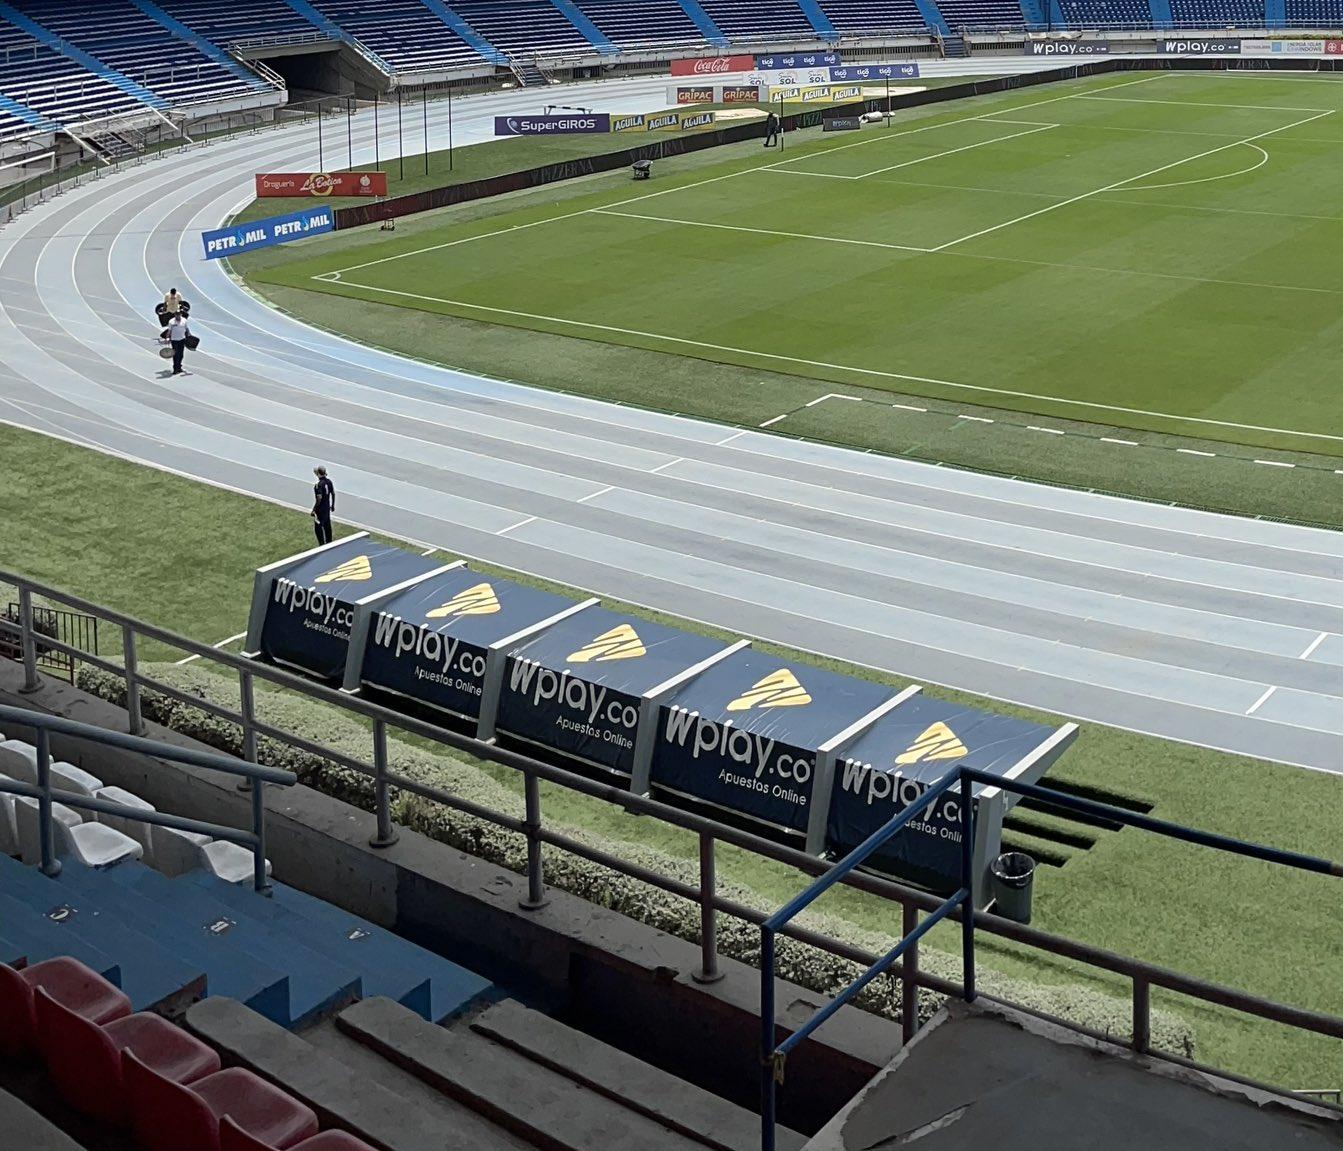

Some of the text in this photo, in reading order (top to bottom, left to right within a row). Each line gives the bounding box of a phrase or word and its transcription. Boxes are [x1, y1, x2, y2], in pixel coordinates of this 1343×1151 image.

[678, 90, 712, 100] GRIPAC
[723, 90, 757, 100] GRIPAC
[521, 119, 595, 132] SuperGIROS
[303, 618, 332, 635] Apuestas
[414, 665, 482, 696] Apuestas Online
[555, 715, 633, 750] Apuestas Online
[718, 769, 807, 806] Apuestas Online
